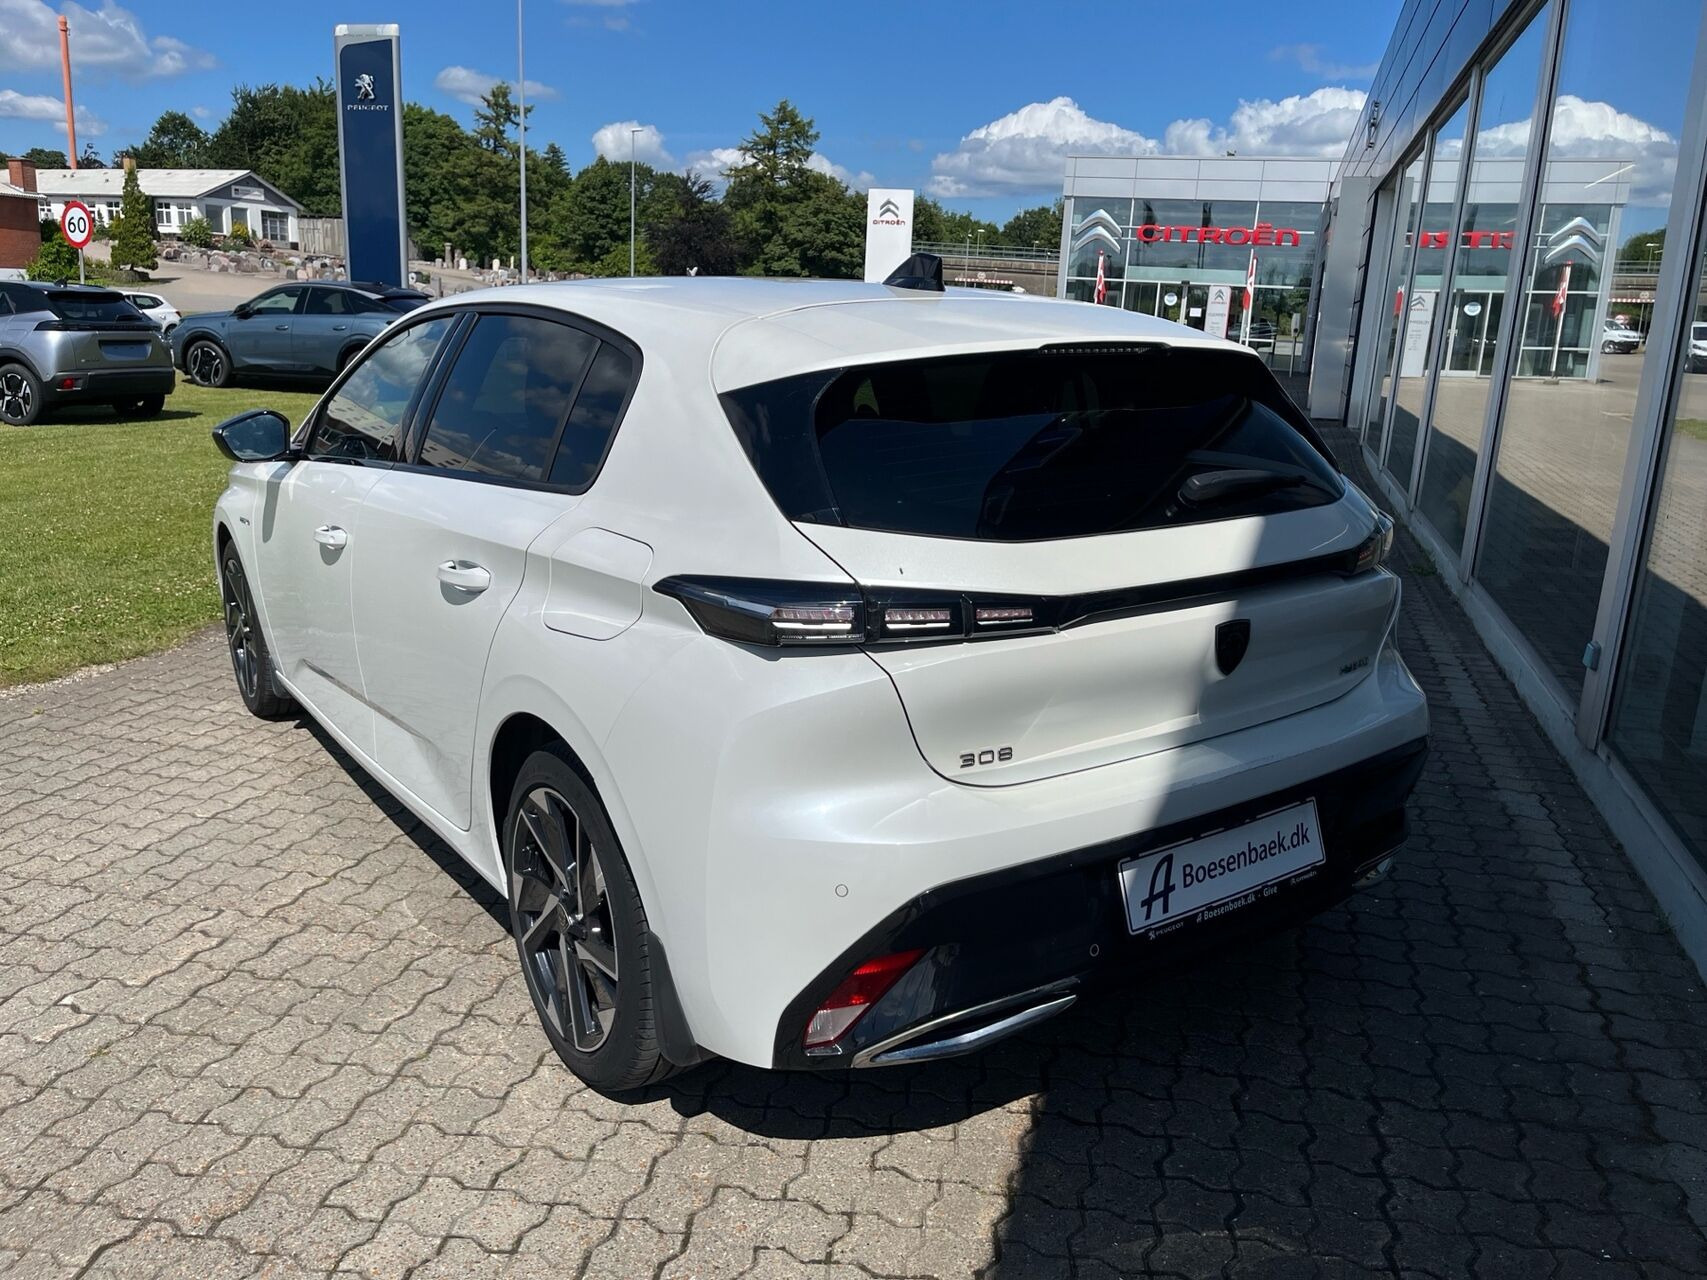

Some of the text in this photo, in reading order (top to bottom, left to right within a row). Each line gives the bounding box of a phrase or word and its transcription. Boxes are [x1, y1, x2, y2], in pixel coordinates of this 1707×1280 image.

[68, 216, 87, 234] 60
[1136, 222, 1300, 248] CITROËN
[959, 746, 1013, 769] 308
[1182, 822, 1311, 889] Boesenbaek.dk
